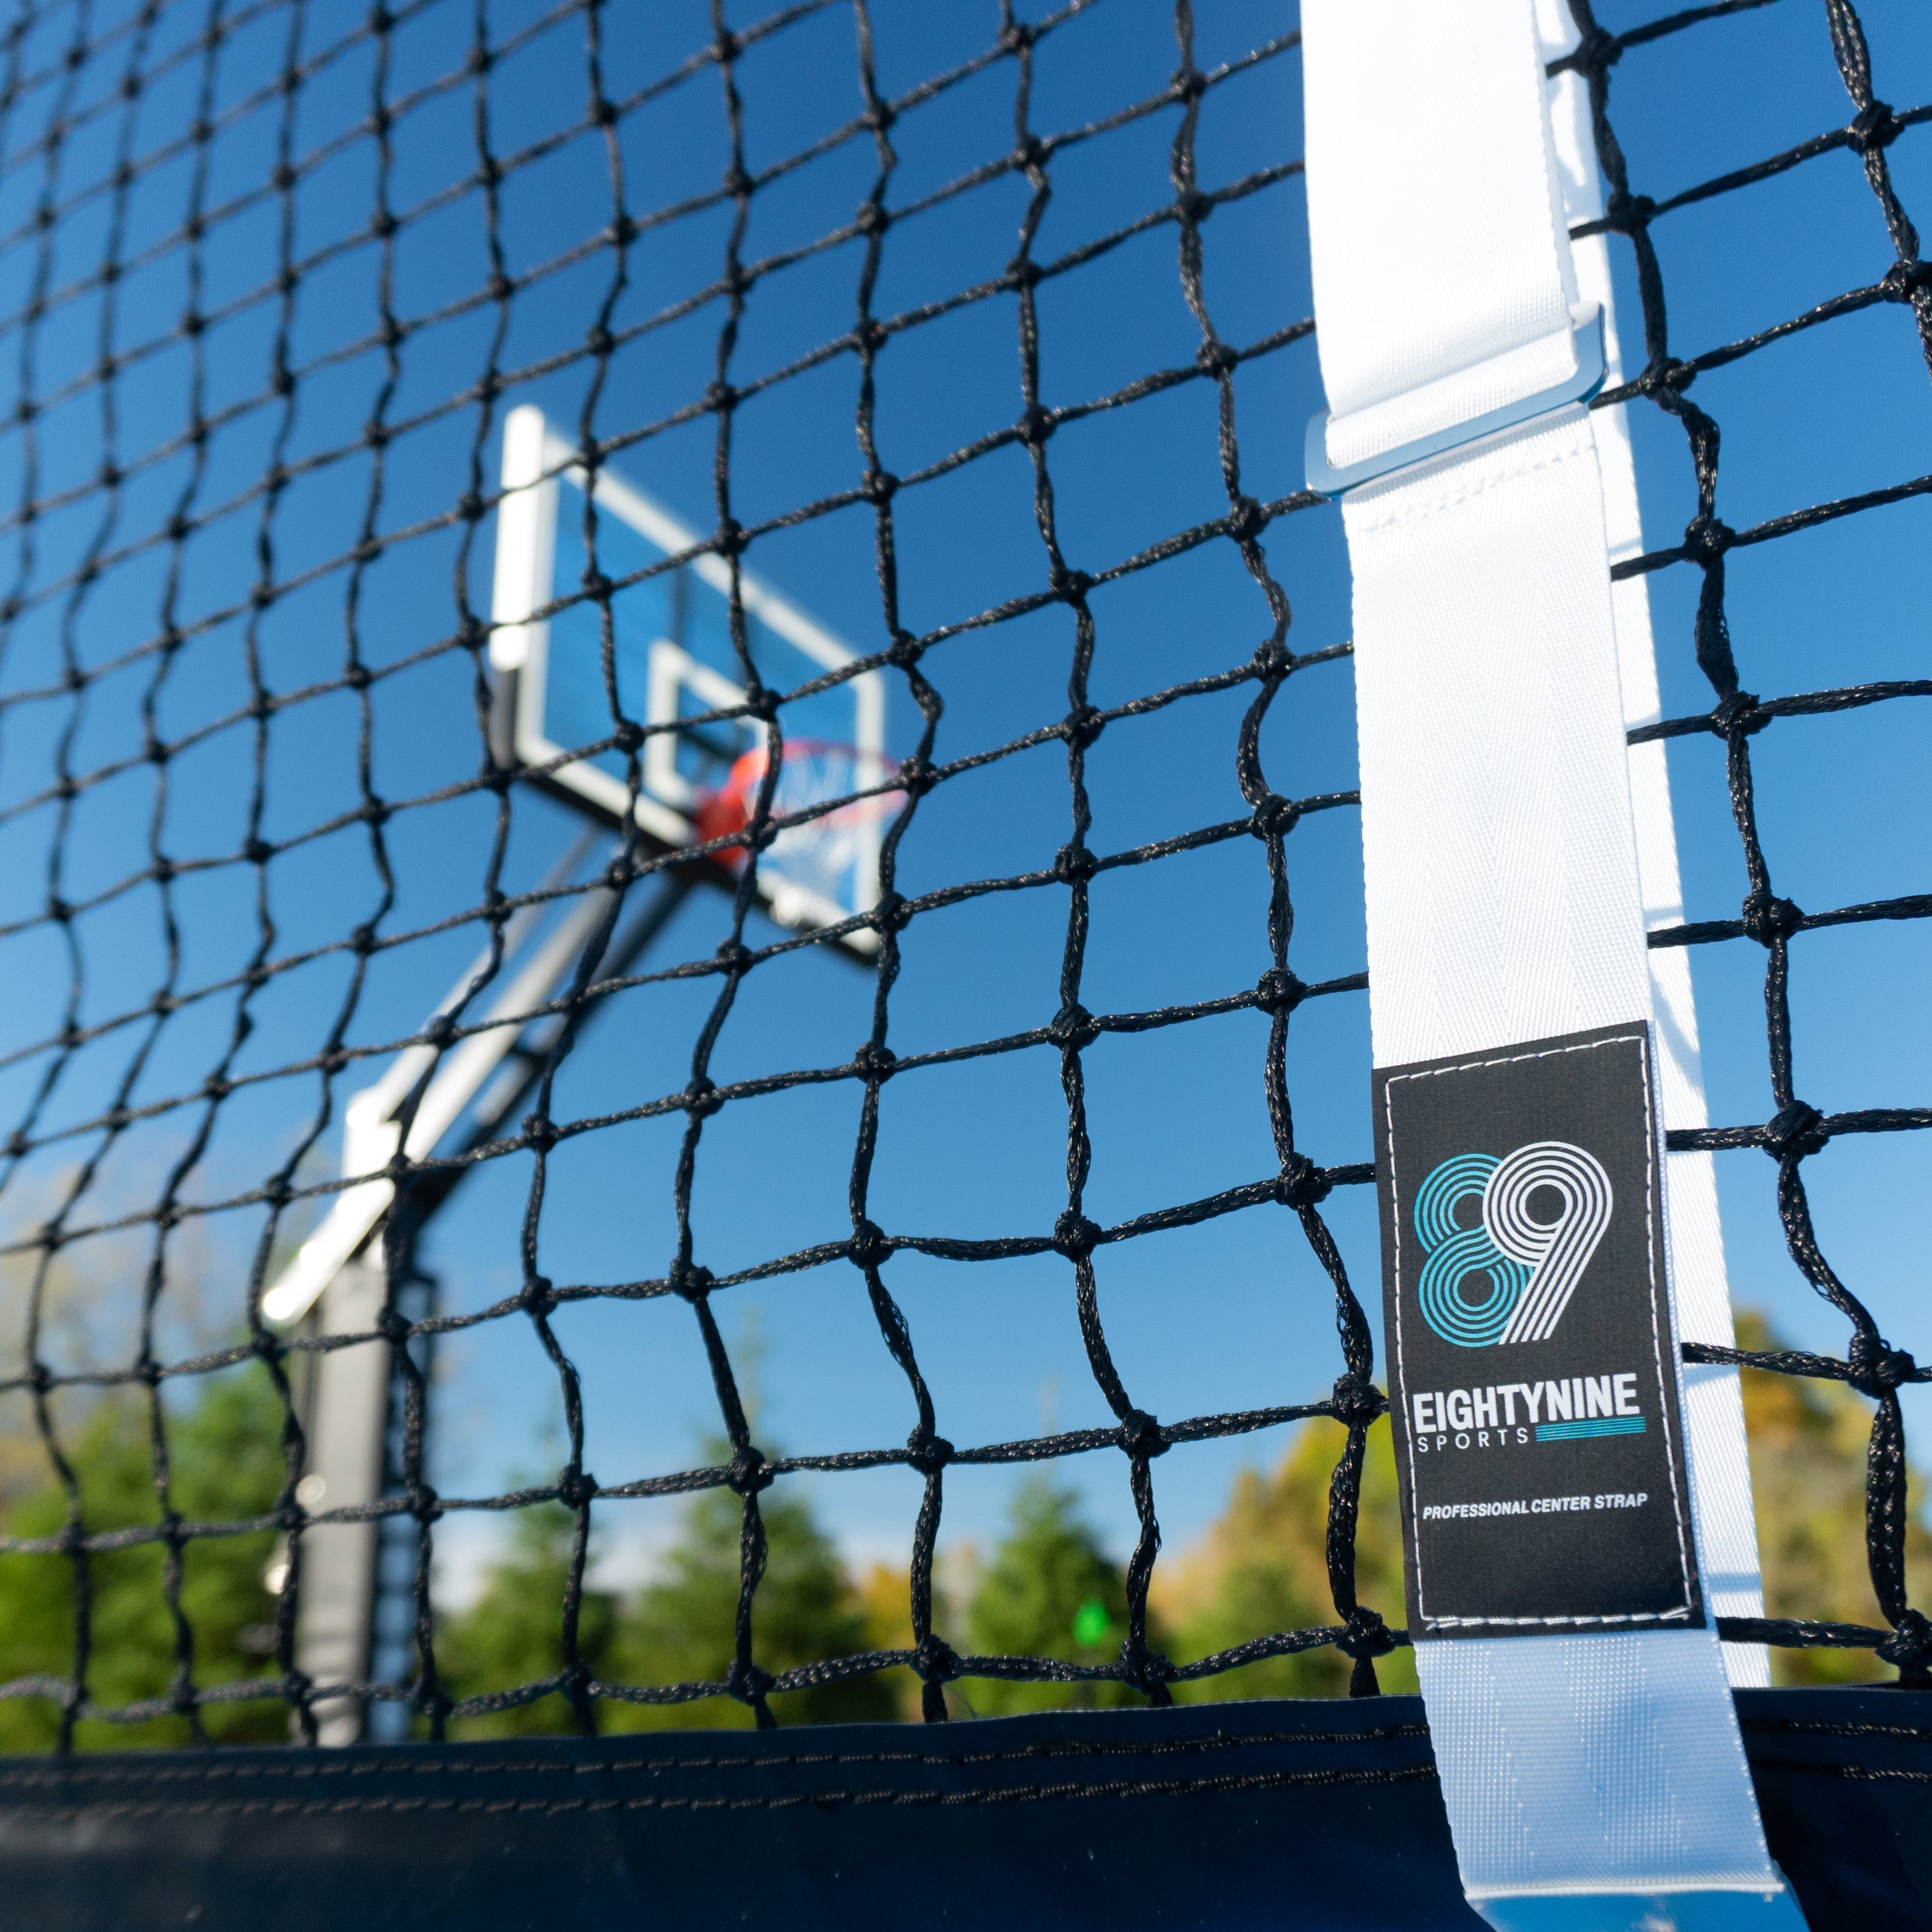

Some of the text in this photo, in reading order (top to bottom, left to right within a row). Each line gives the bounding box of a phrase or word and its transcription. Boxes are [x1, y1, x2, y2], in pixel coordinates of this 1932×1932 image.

[1414, 1141, 1614, 1348] 89
[1413, 1373, 1641, 1434] EIGHTYNINE
[1417, 1427, 1529, 1453] SPORTS
[1422, 1493, 1649, 1520] PROFESSIONAL CENTER STRAP
